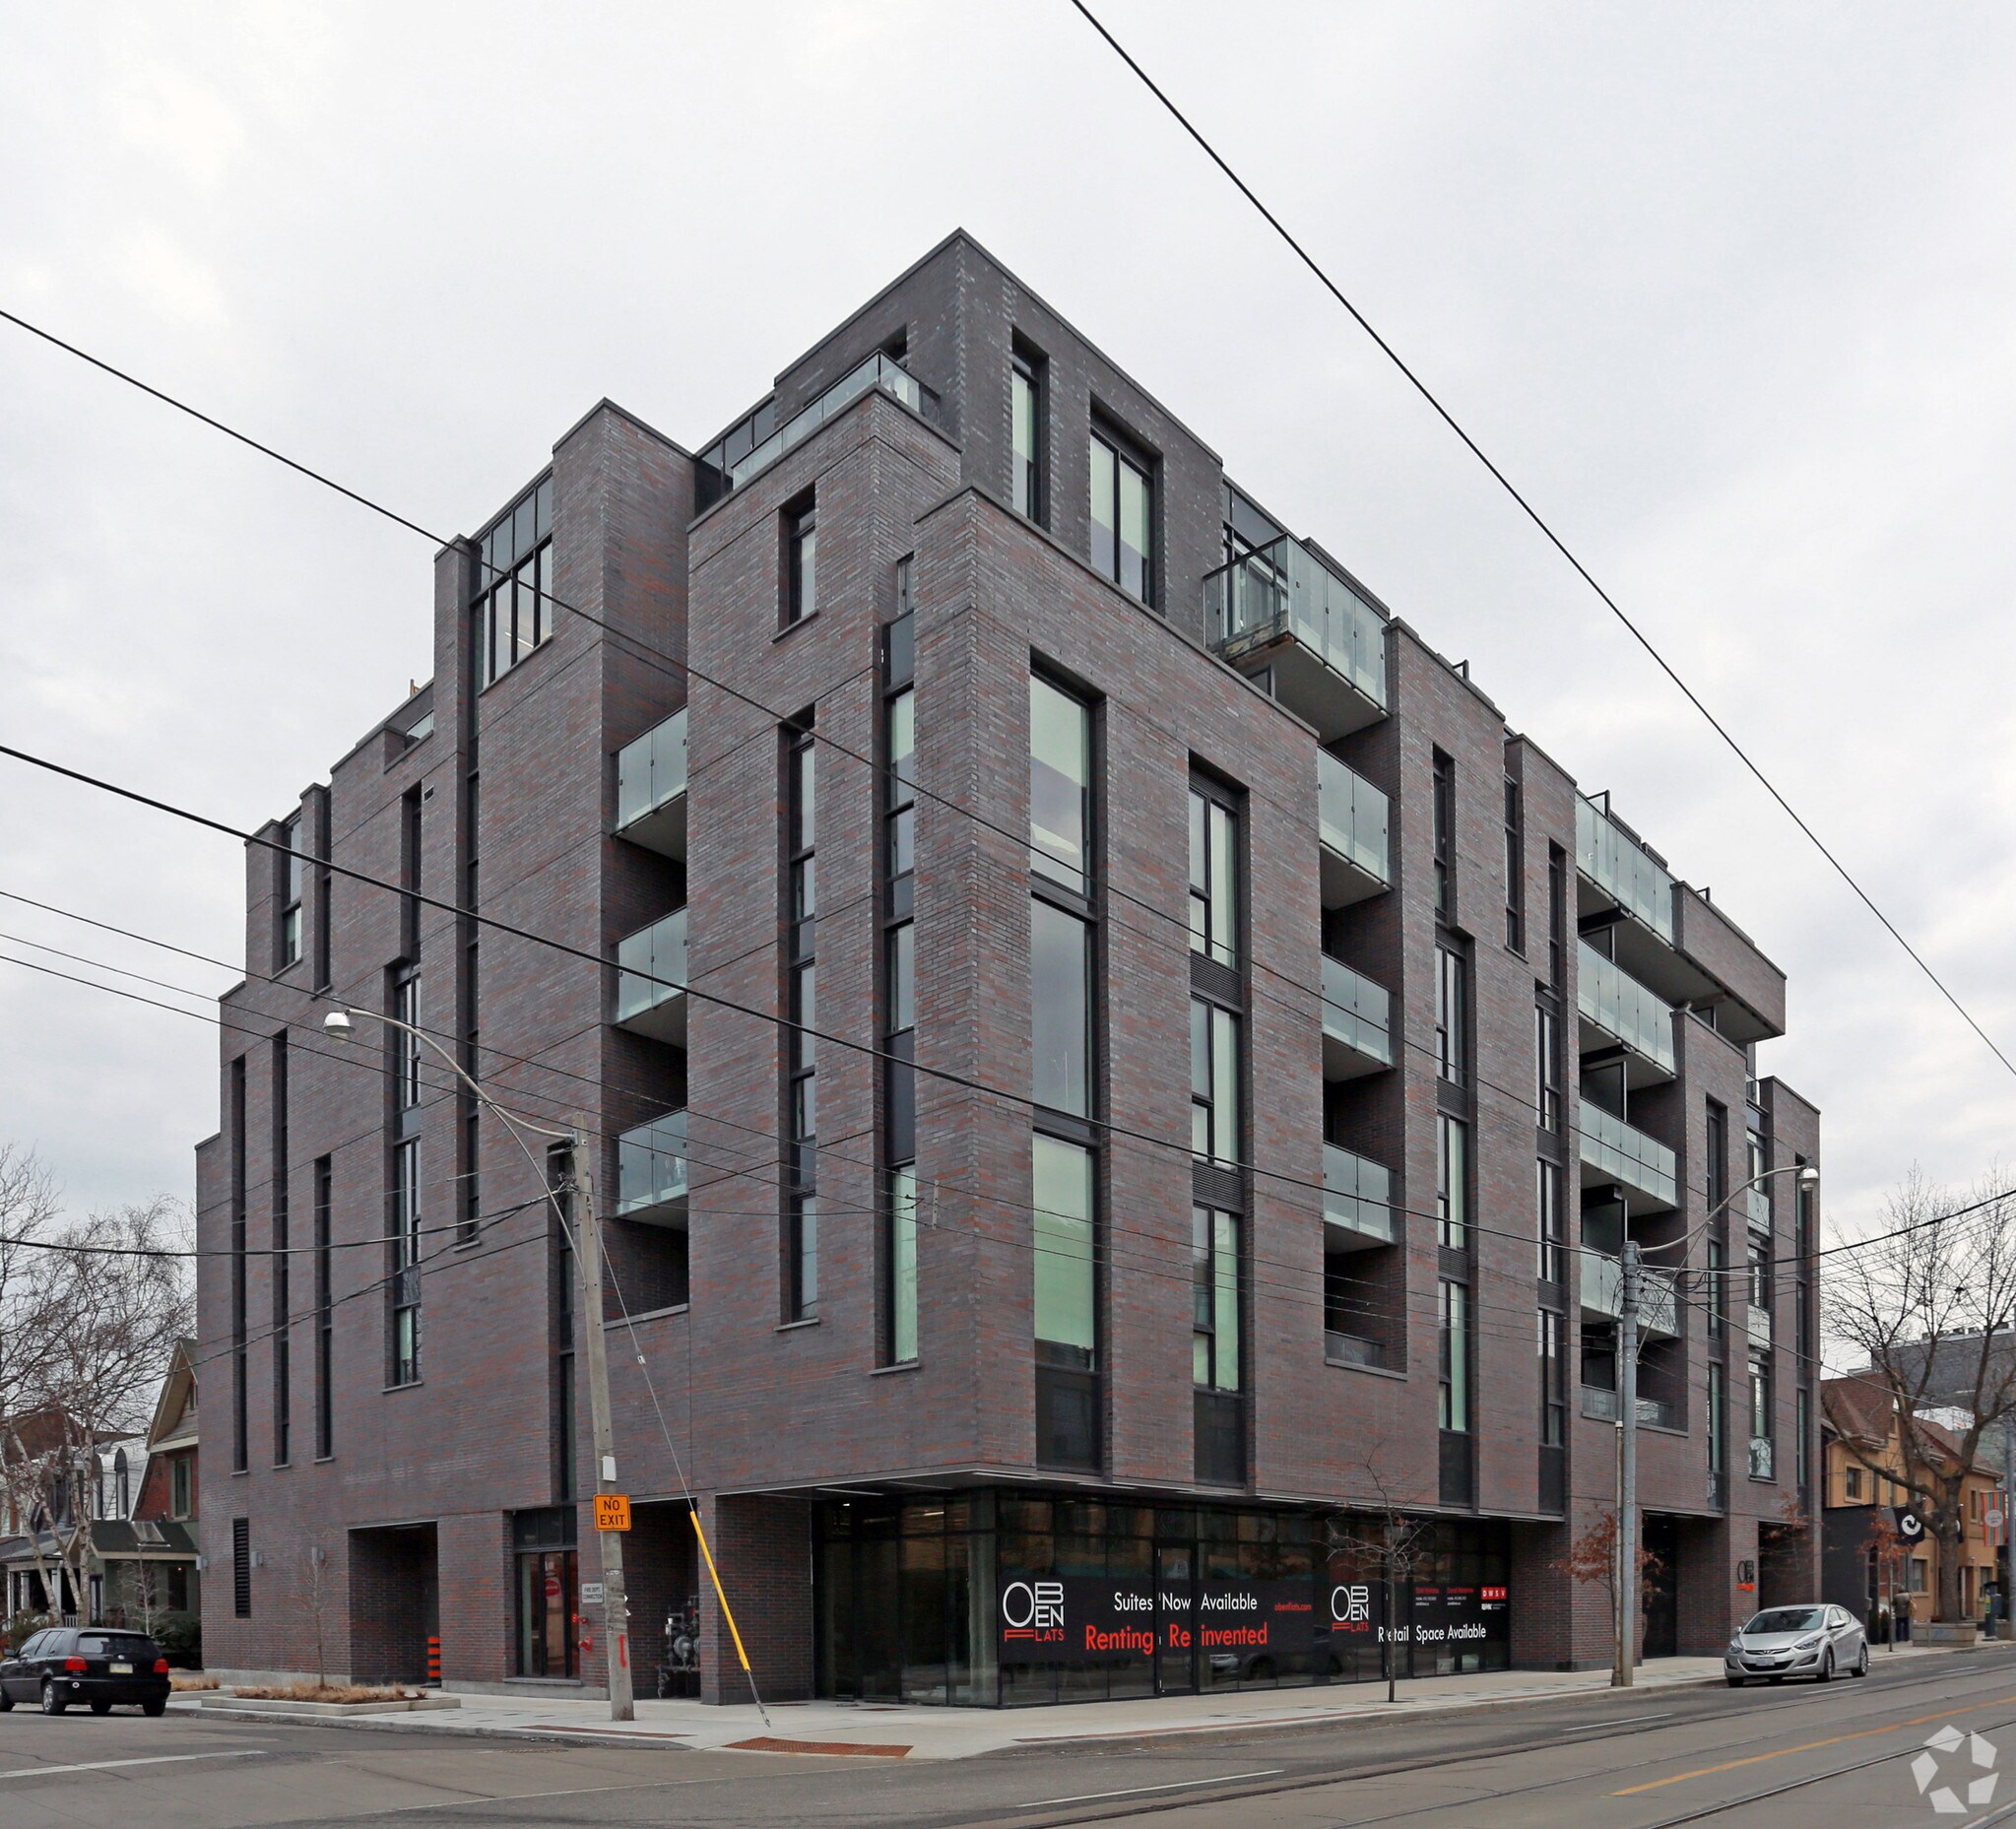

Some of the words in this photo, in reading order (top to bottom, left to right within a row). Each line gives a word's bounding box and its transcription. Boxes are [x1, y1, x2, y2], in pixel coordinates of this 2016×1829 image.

[603, 1499, 620, 1511] NO
[600, 1514, 625, 1526] EXIT
[1114, 1592, 1153, 1611] Suites
[1162, 1593, 1192, 1611] Now
[1201, 1592, 1259, 1611] Available
[1332, 1621, 1370, 1633] FLATS
[1415, 1624, 1445, 1645] Space
[1447, 1623, 1487, 1640] Available
[1004, 1628, 1066, 1643] FLATS
[1085, 1624, 1154, 1656] Renting
